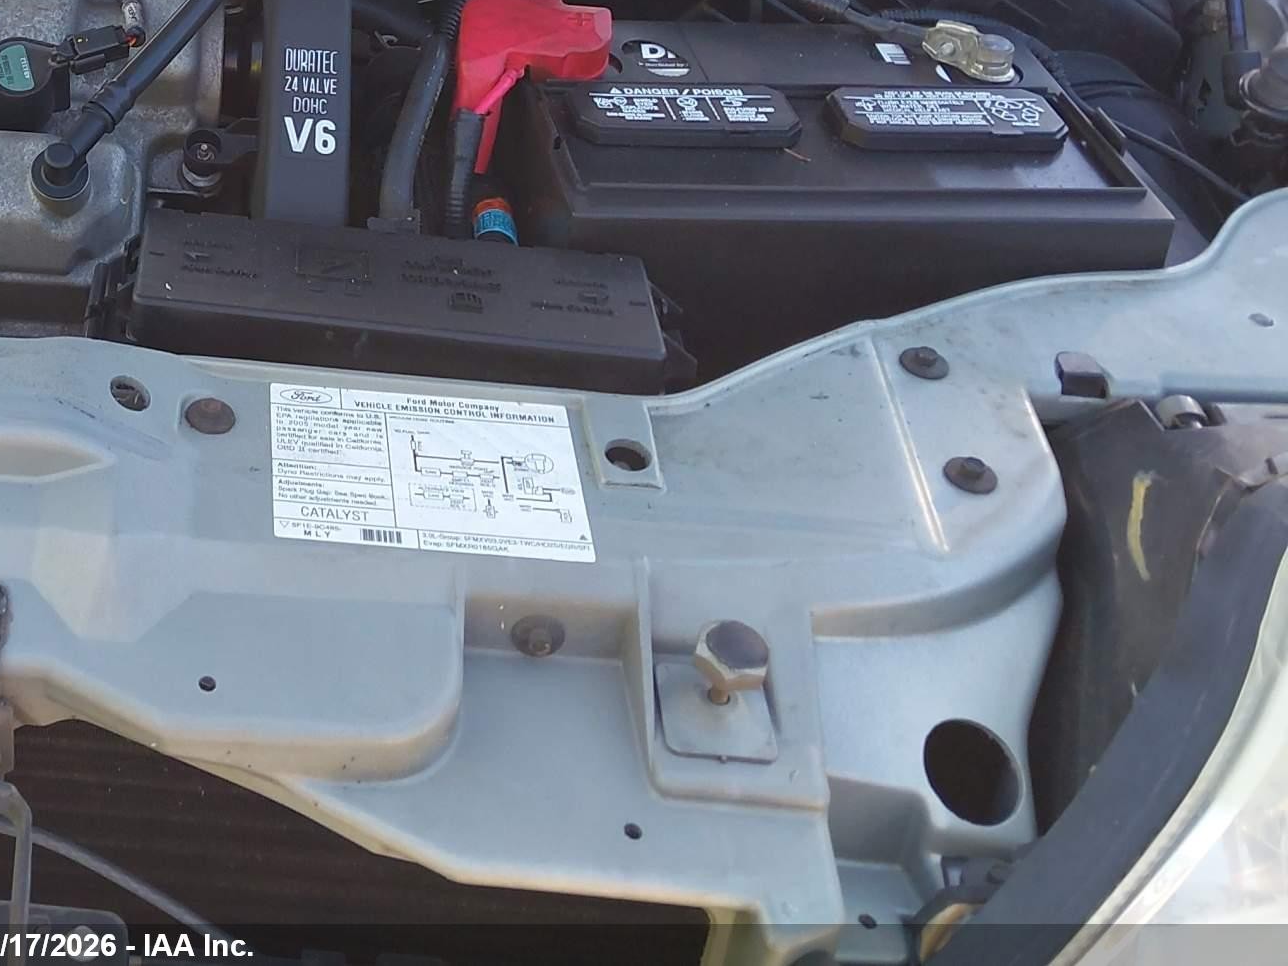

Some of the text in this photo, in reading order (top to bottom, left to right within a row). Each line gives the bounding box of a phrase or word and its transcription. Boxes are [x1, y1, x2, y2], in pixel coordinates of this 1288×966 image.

[285, 48, 338, 74] DURATEC
[284, 76, 337, 95] 24 VALVE
[692, 88, 744, 96] POISON
[293, 96, 328, 114] DOHC
[283, 116, 336, 155] V6
[290, 391, 321, 402] Ford
[406, 397, 500, 412] Ford Motor Company
[354, 400, 392, 411] VEHICLE
[395, 404, 441, 415] EMISSION
[443, 408, 486, 419] CONTROL
[489, 411, 555, 423] INFORMATION
[300, 505, 369, 522] CATALYST
